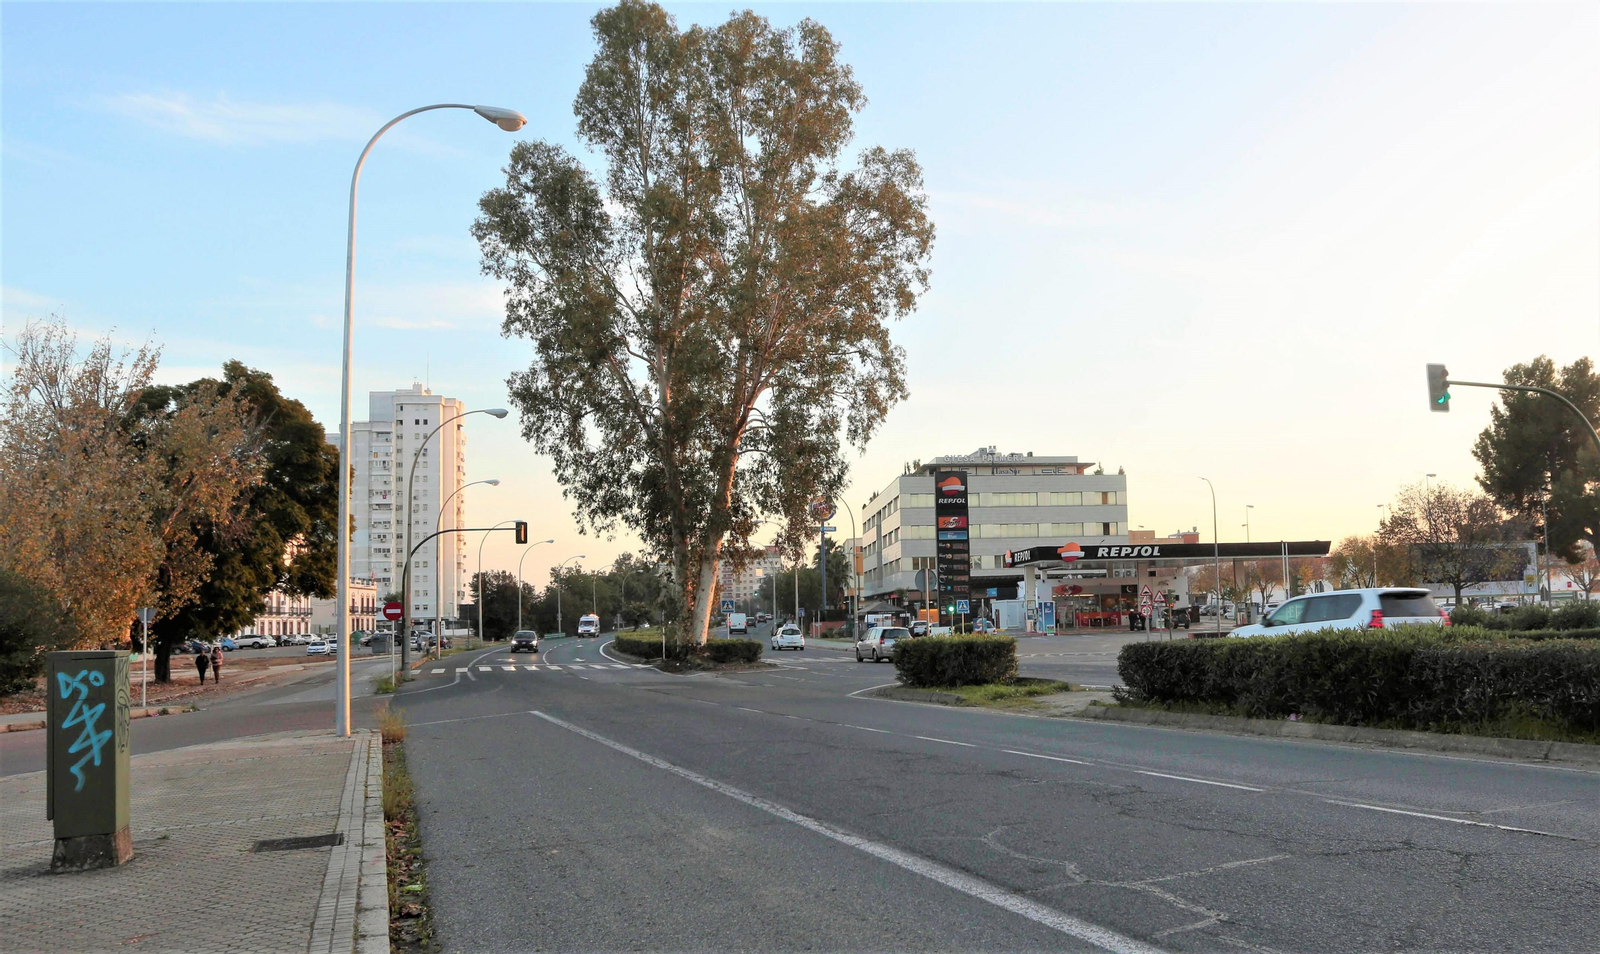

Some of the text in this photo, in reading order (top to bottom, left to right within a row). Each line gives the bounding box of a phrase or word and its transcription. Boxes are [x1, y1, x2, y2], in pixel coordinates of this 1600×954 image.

[982, 454, 1026, 462] PALMERA
[1014, 550, 1031, 562] REPSOL
[1097, 546, 1161, 557] REPSOL
